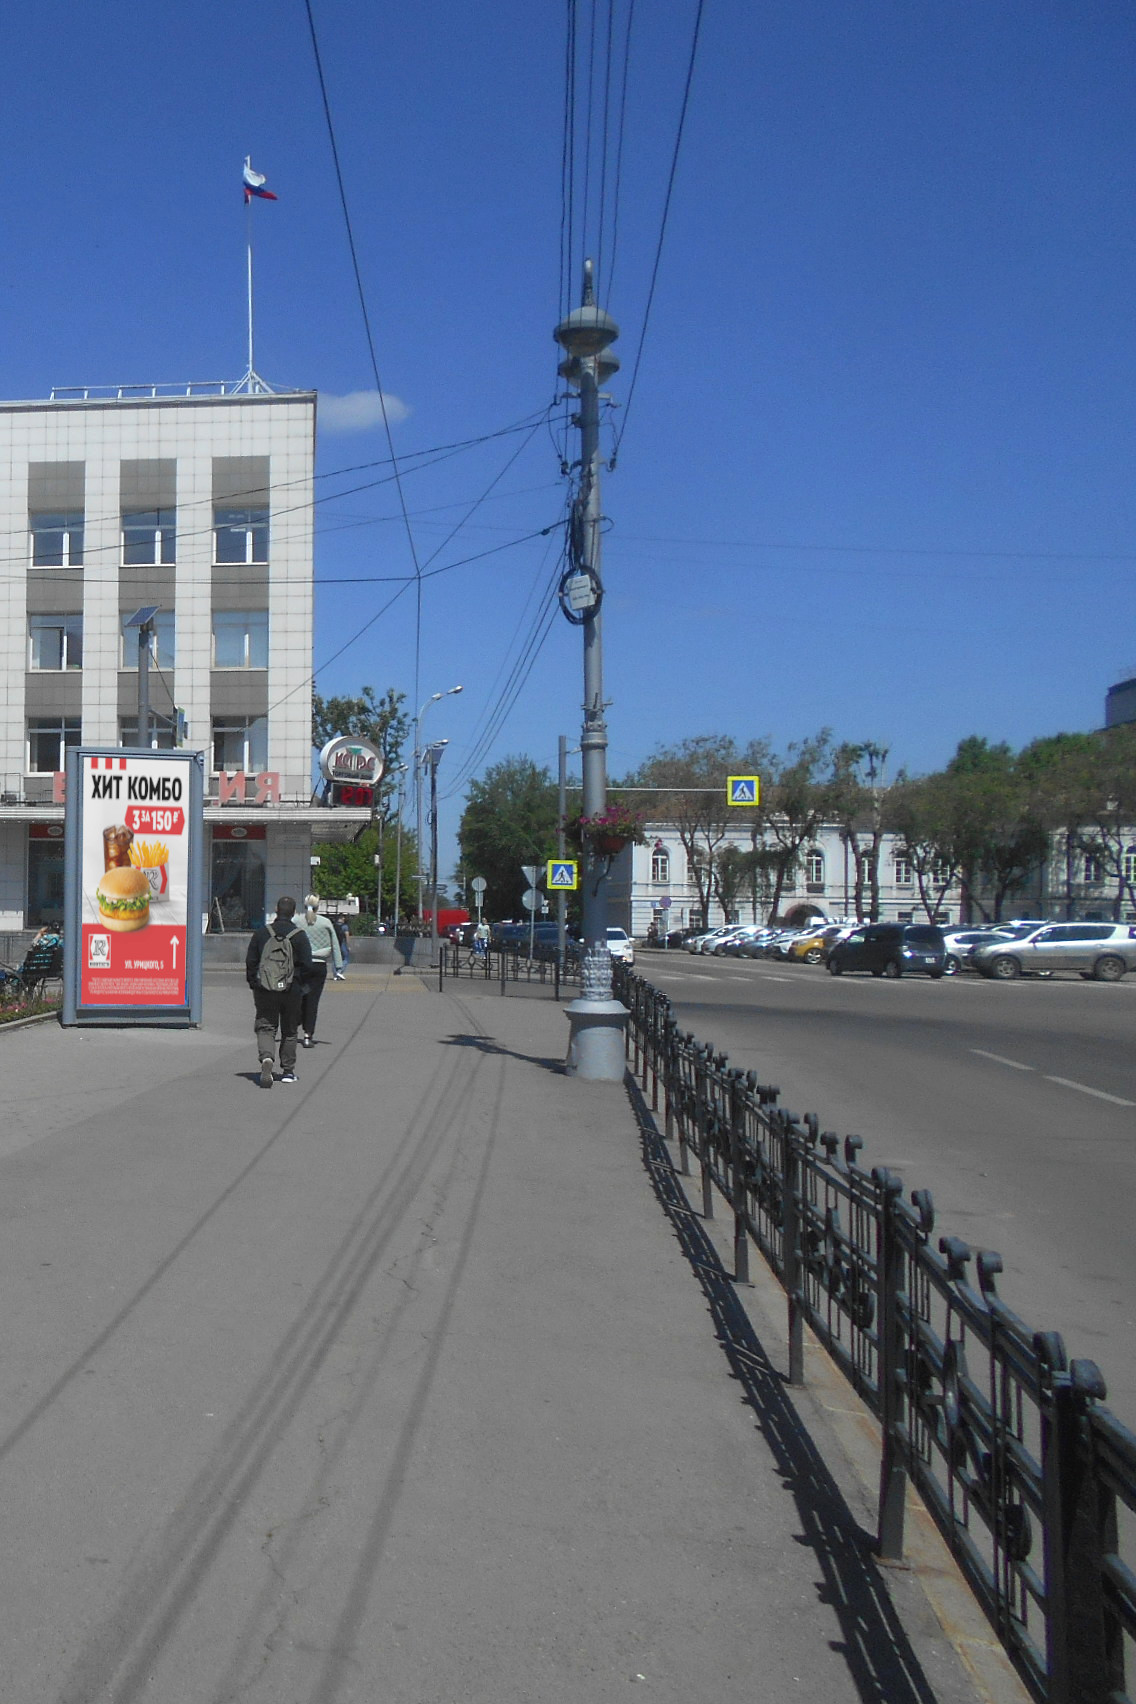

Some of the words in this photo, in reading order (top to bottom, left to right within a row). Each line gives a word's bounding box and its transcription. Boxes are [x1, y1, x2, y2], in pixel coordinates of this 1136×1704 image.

[91, 775, 123, 799] ХИТ
[127, 776, 182, 802] КОМБО
[132, 809, 140, 831] 3
[141, 809, 150, 822] ЗА
